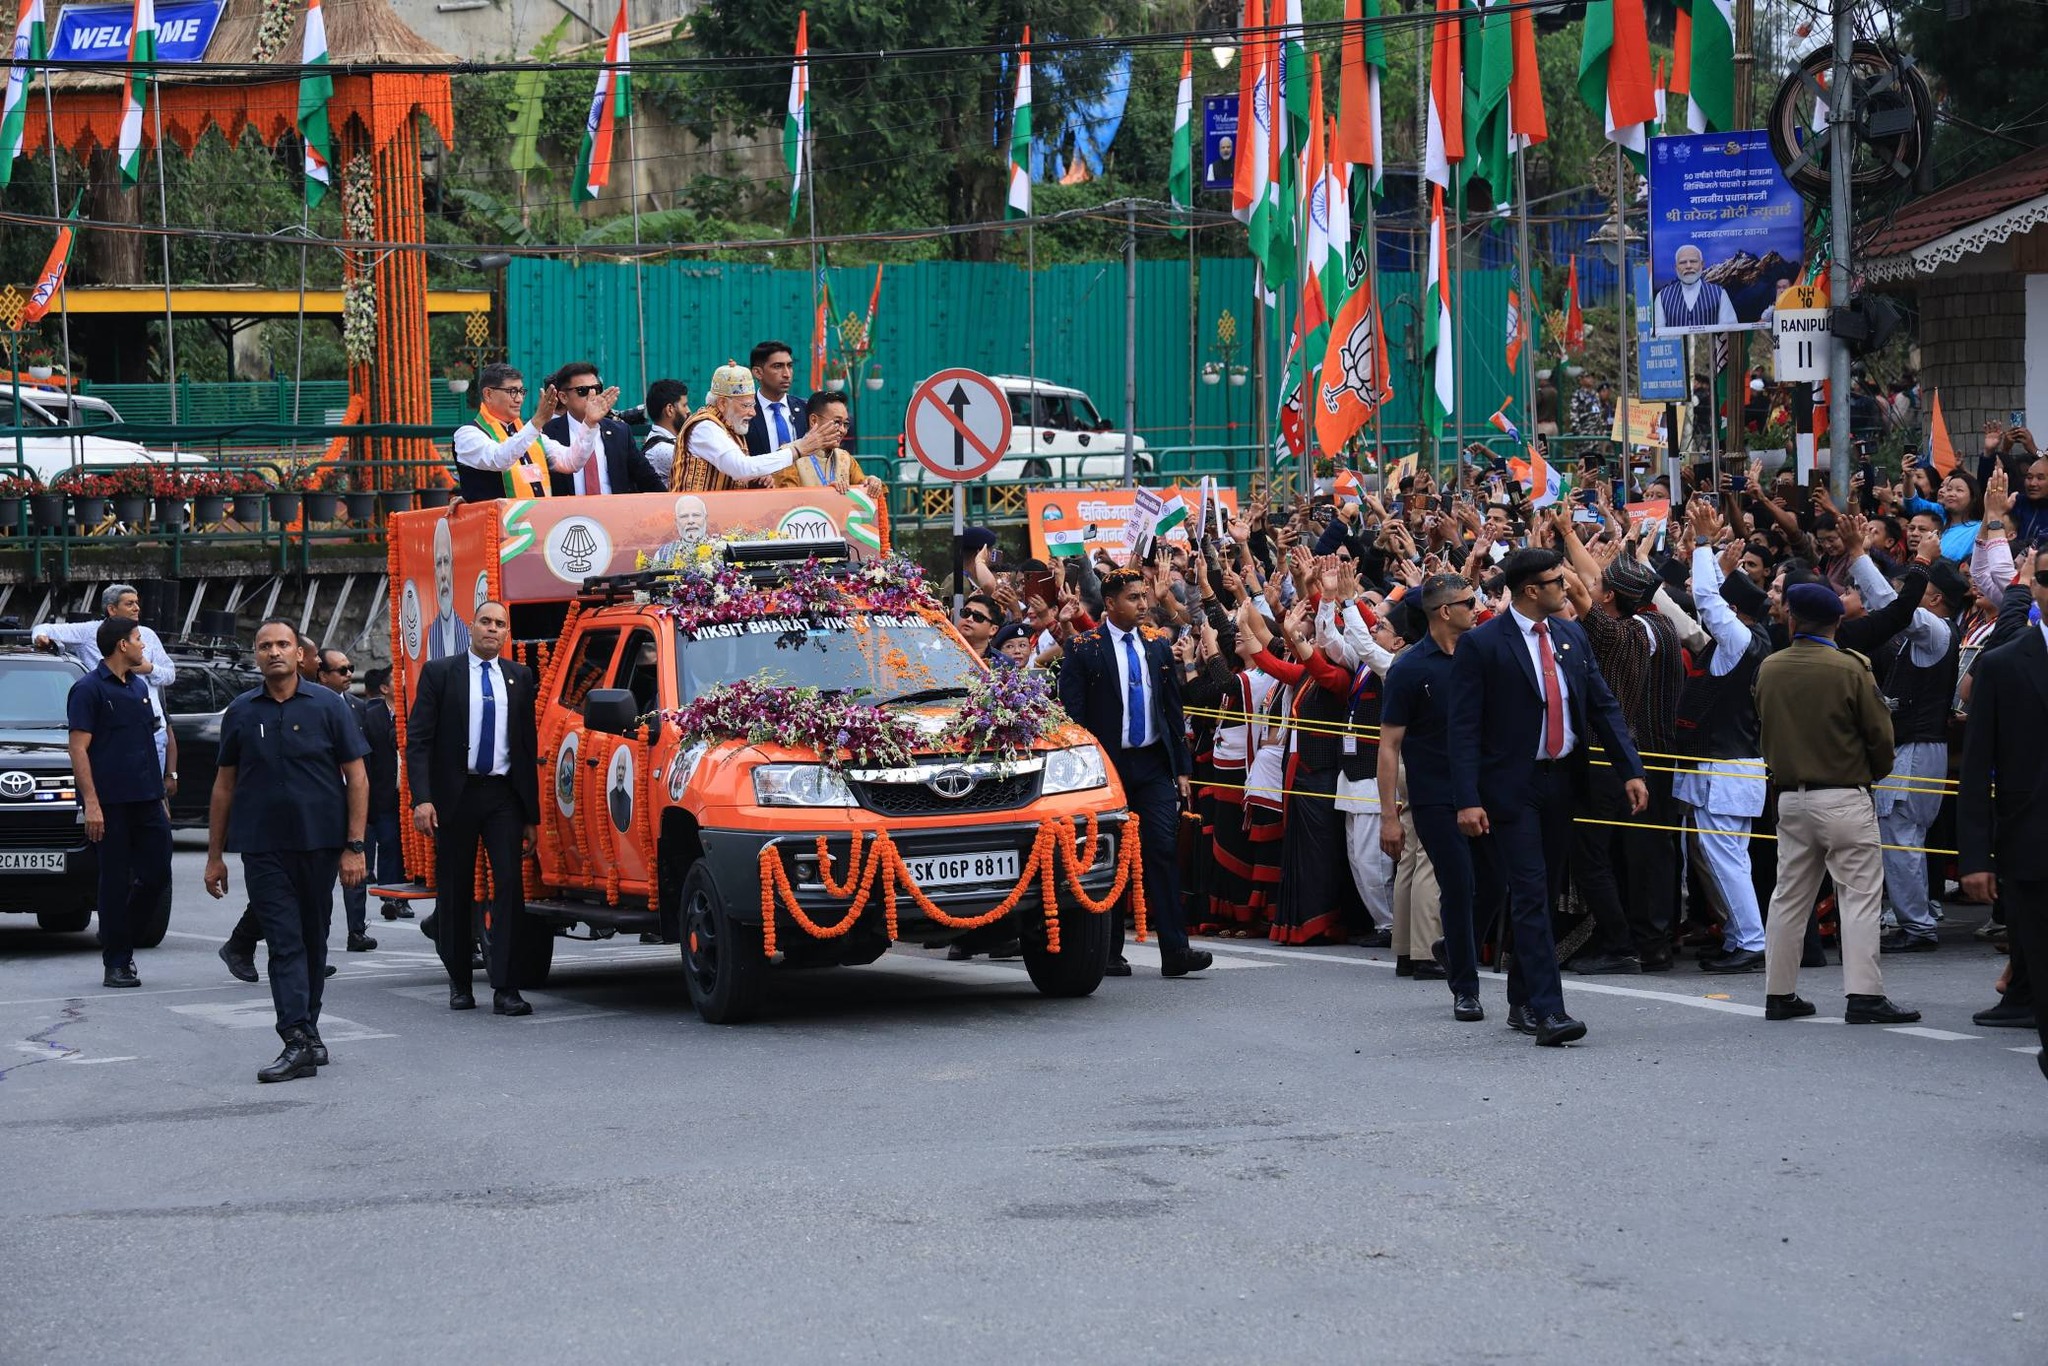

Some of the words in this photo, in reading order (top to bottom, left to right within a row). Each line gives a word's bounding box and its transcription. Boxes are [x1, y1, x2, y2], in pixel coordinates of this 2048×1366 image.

[72, 18, 201, 50] WELME
[1690, 193, 1723, 204] माननीय
[1666, 208, 1680, 221] श्री
[1684, 207, 1717, 220] नरेन्द्र
[1798, 288, 1815, 297] NH
[1801, 298, 1813, 308] 10
[1077, 501, 1135, 521] सिक्किमवा
[692, 622, 744, 641] VIKSIT
[747, 618, 811, 634] BHARAT
[821, 616, 870, 629] VIKST
[914, 862, 935, 881] SK
[939, 860, 969, 879] 06P
[975, 857, 1013, 876] 8811
